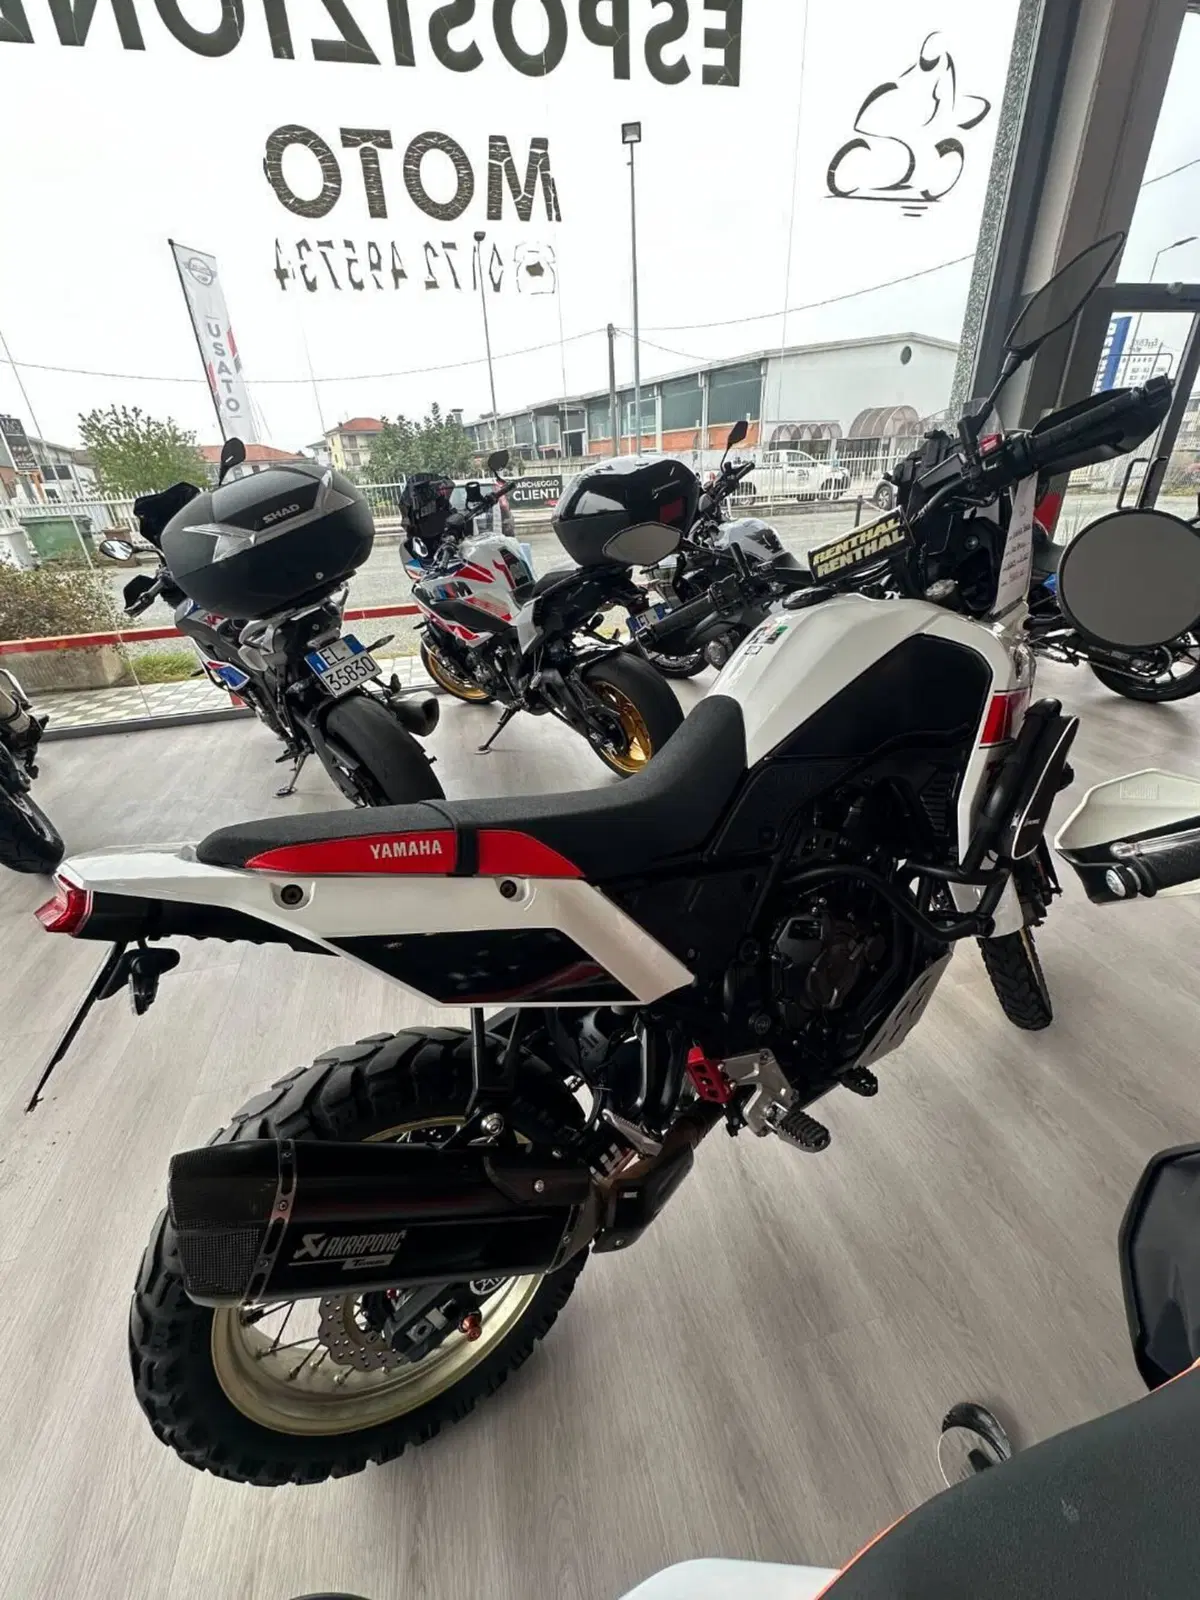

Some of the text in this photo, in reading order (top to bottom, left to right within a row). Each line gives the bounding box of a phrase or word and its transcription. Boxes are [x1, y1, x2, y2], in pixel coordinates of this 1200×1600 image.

[206, 321, 241, 413] USATO
[512, 487, 561, 502] CLIENTI
[514, 479, 560, 490] ARCHEGGIO
[262, 503, 300, 524] SHAD
[812, 517, 901, 567] RENTHAL
[817, 528, 906, 578] RENTHAL
[318, 645, 347, 667] EL
[324, 656, 376, 691] 35830
[369, 839, 443, 860] YAMAHA
